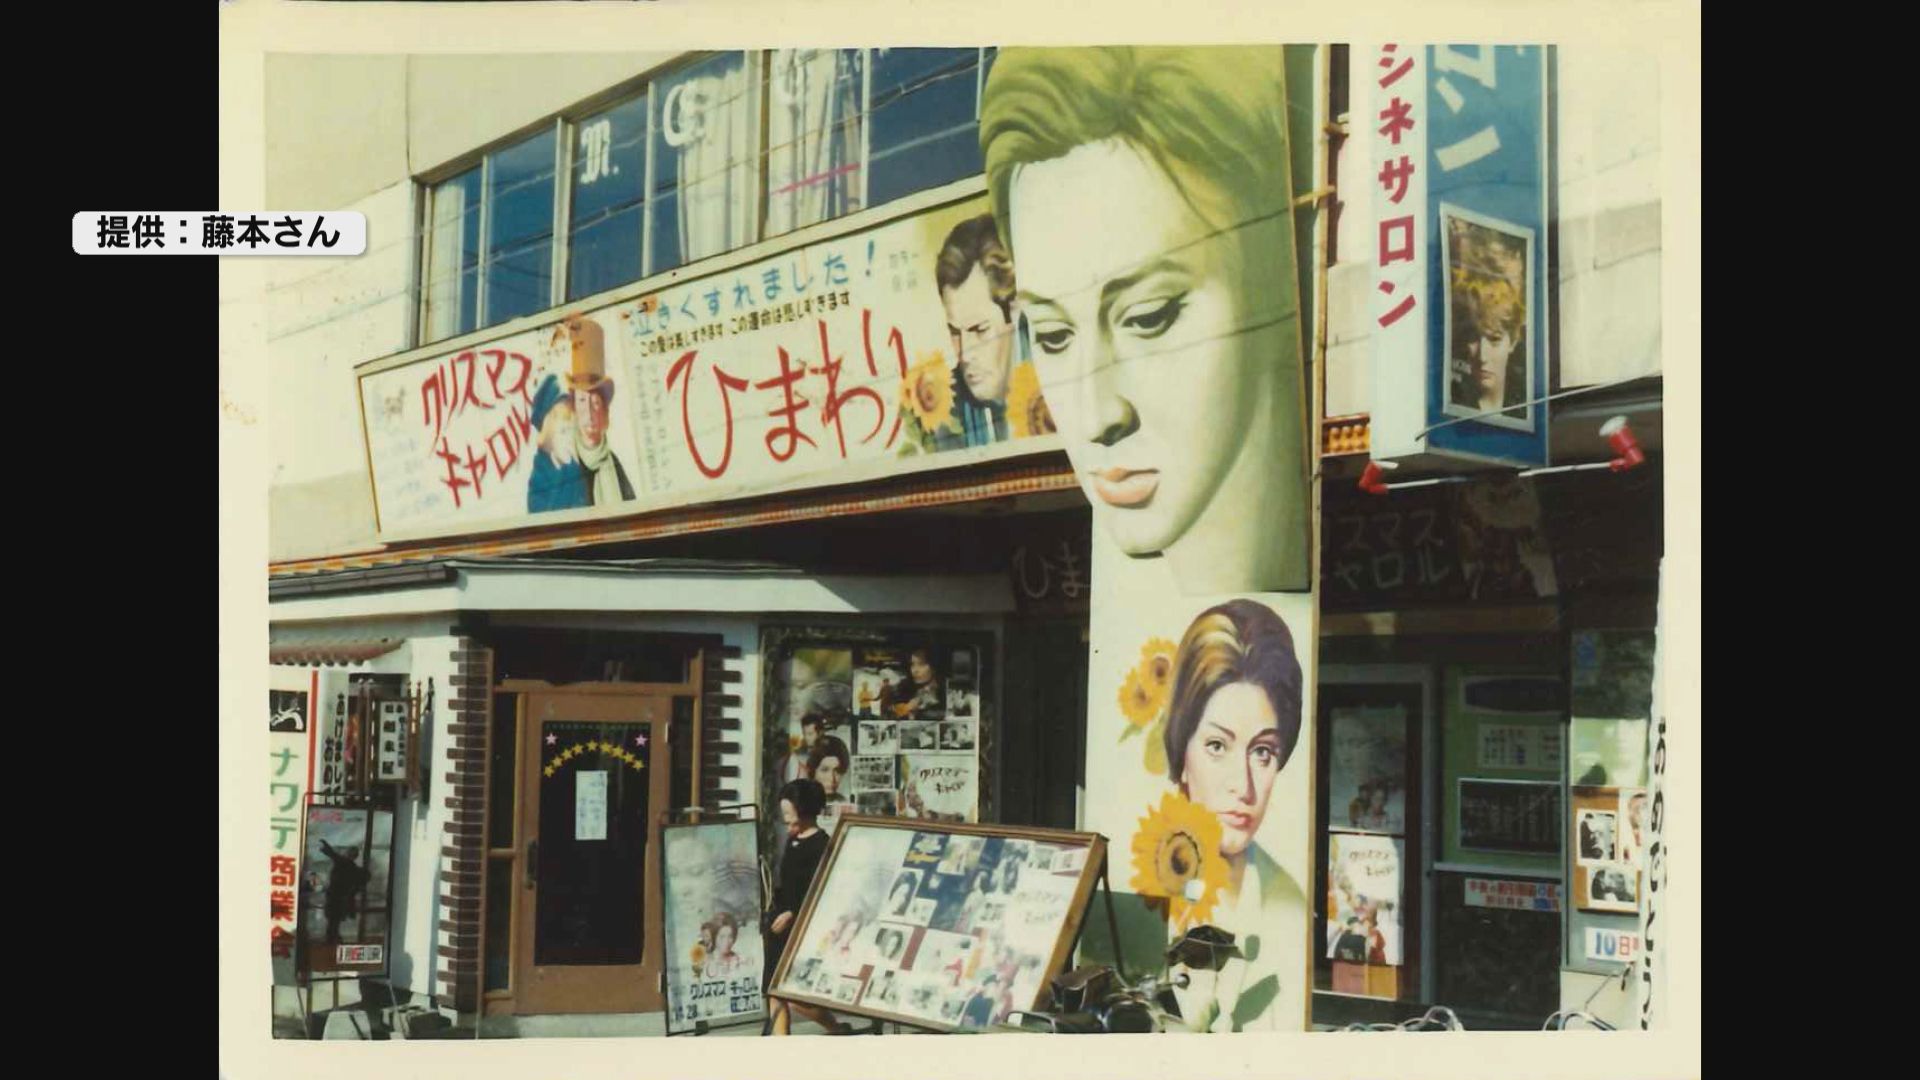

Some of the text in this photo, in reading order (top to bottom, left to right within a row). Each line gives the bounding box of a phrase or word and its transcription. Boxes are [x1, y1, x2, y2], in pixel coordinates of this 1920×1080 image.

[1377, 43, 1416, 329] シネサロン
[421, 349, 536, 448] クリスマス
[435, 404, 532, 510] キャロル
[665, 307, 909, 480] ひまわり
